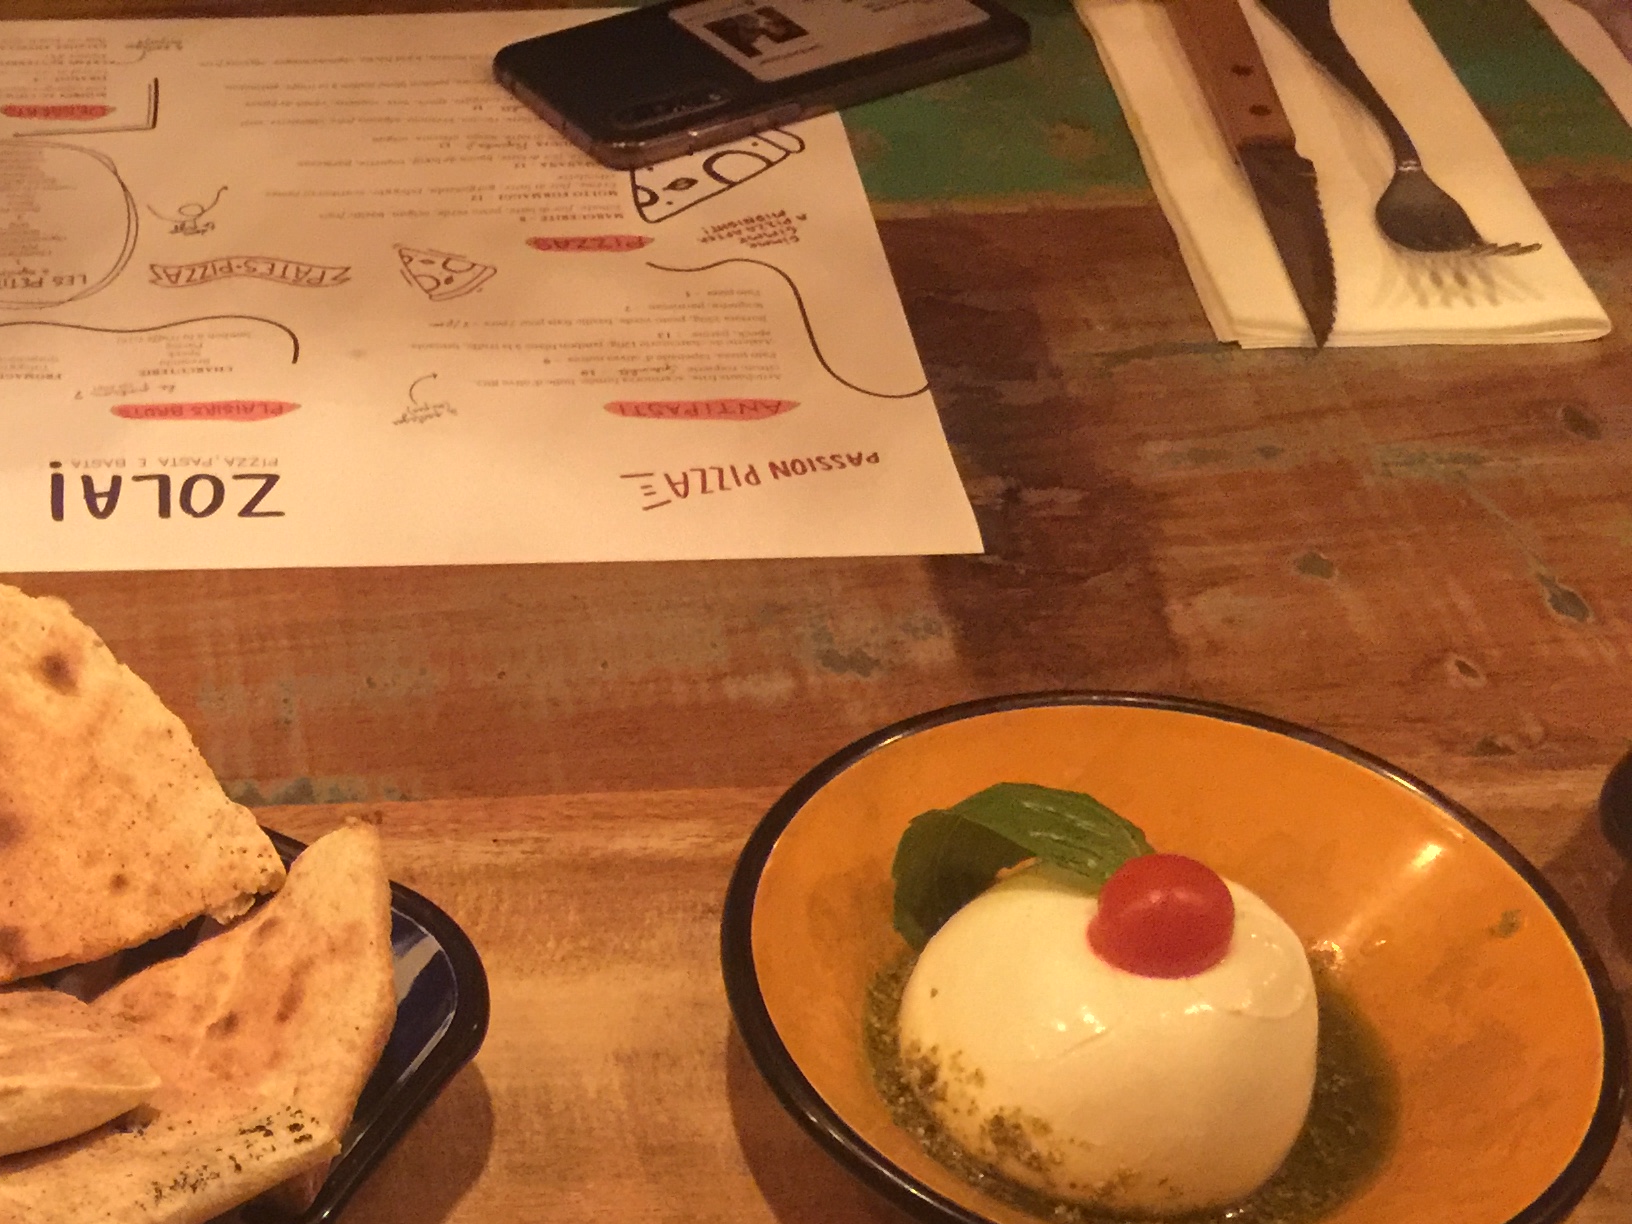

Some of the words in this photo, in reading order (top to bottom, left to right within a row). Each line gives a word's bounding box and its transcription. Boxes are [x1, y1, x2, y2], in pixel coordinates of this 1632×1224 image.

[618, 400, 782, 416] ANTIPASTI
[664, 463, 761, 500] PIZZA
[768, 450, 881, 480] PASSION
[48, 460, 286, 522] ZOLA!
